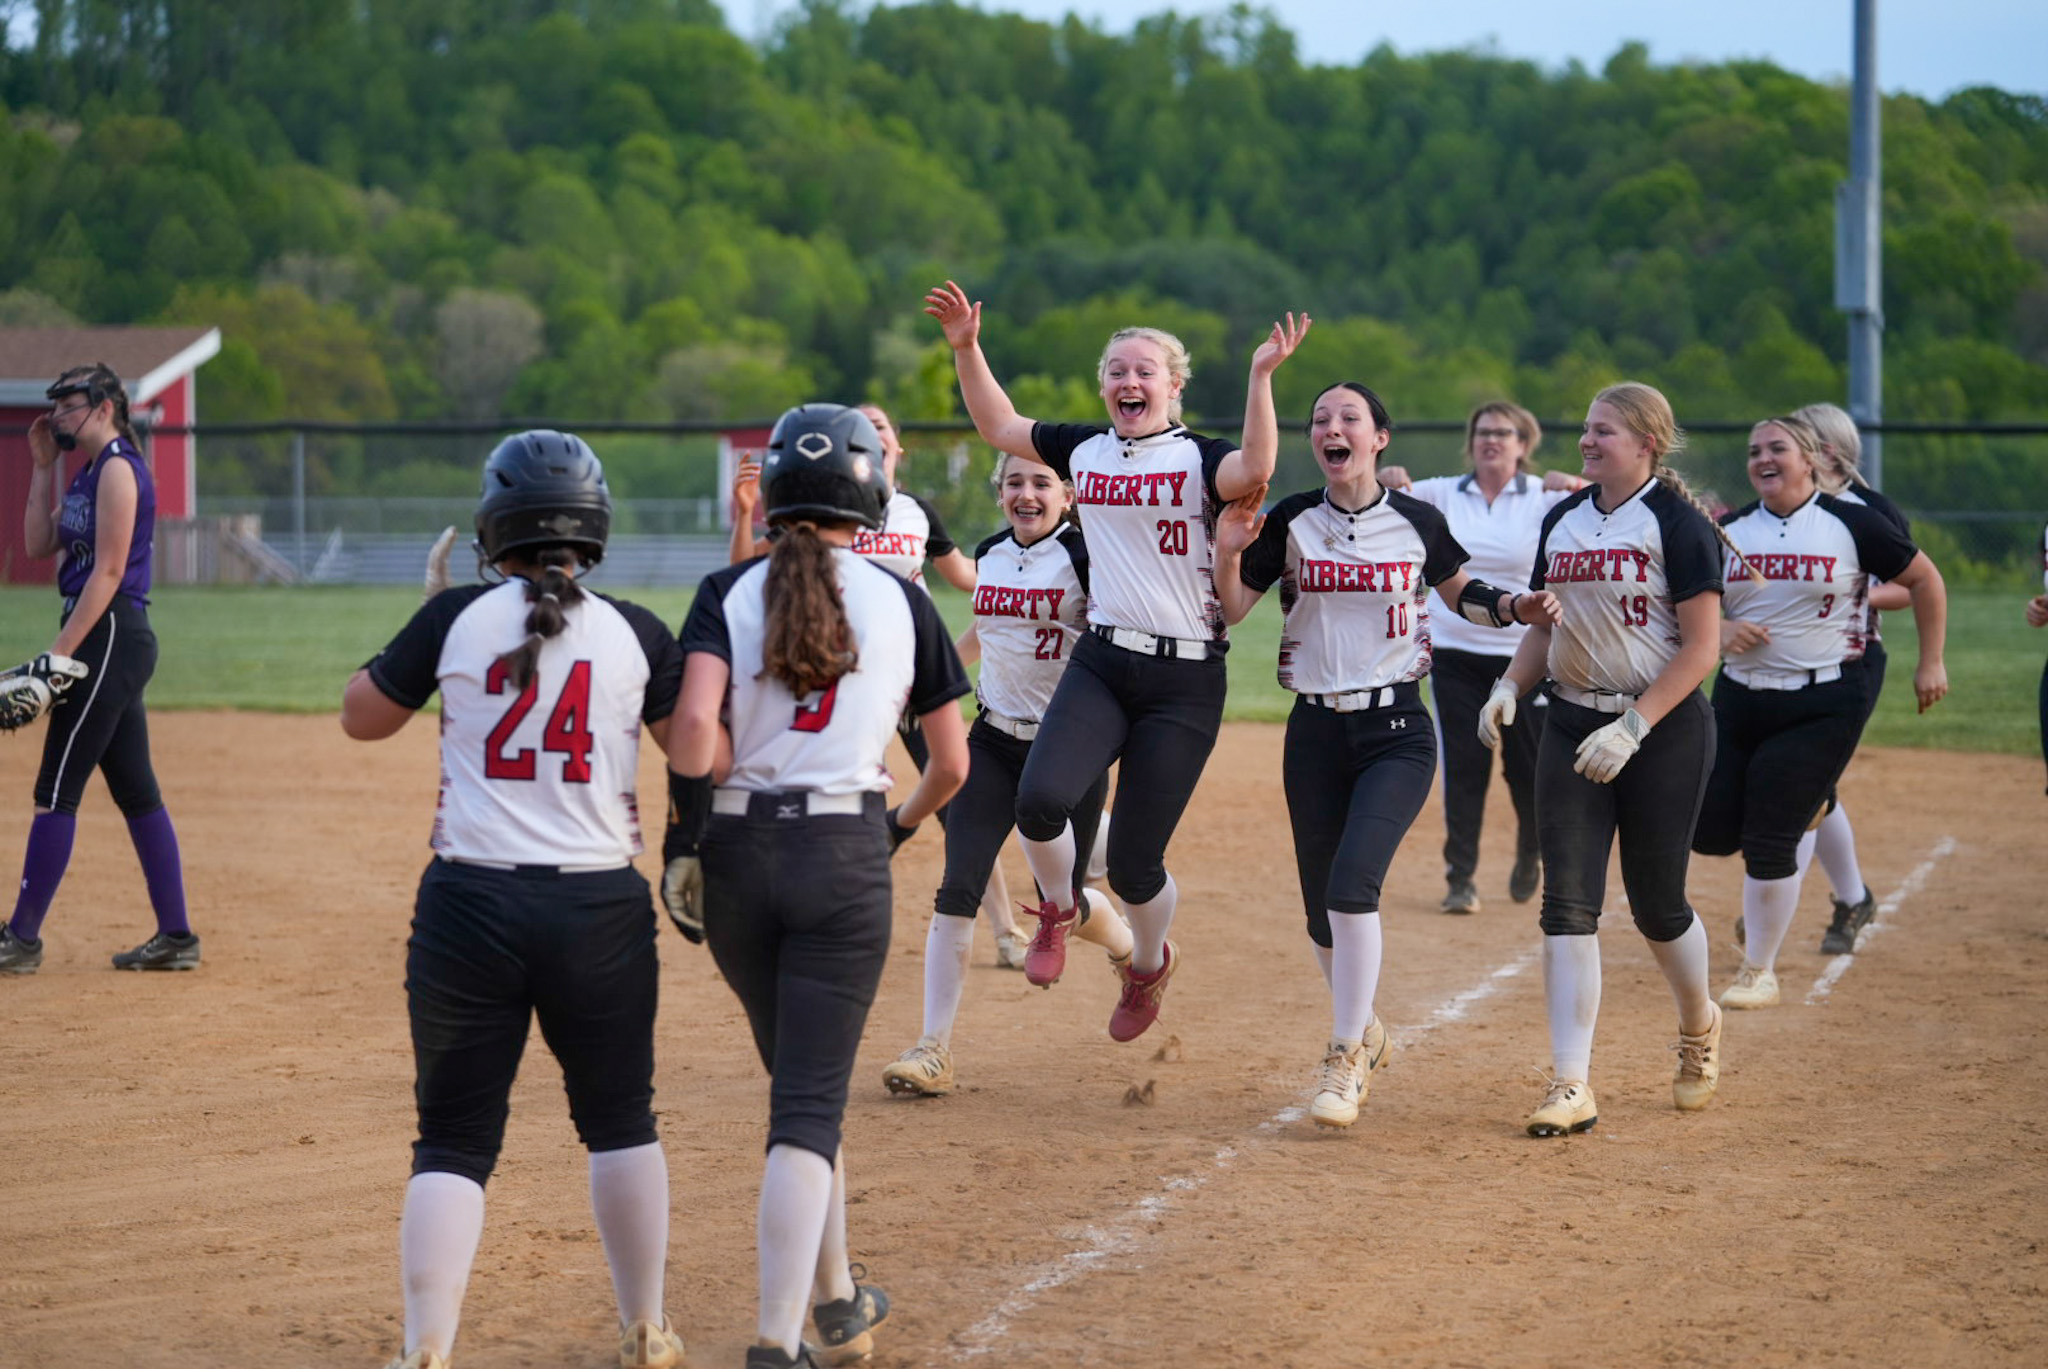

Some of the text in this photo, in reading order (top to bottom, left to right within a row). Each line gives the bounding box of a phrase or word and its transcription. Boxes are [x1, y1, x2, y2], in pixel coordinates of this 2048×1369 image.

[1077, 470, 1187, 507] LIBERTY
[1157, 519, 1188, 556] 20
[973, 585, 1065, 620] IBERTY
[1386, 602, 1408, 639] 10
[1620, 594, 1648, 627] 19
[1817, 593, 1836, 619] 3
[1035, 628, 1064, 660] 27
[485, 656, 594, 784] 24
